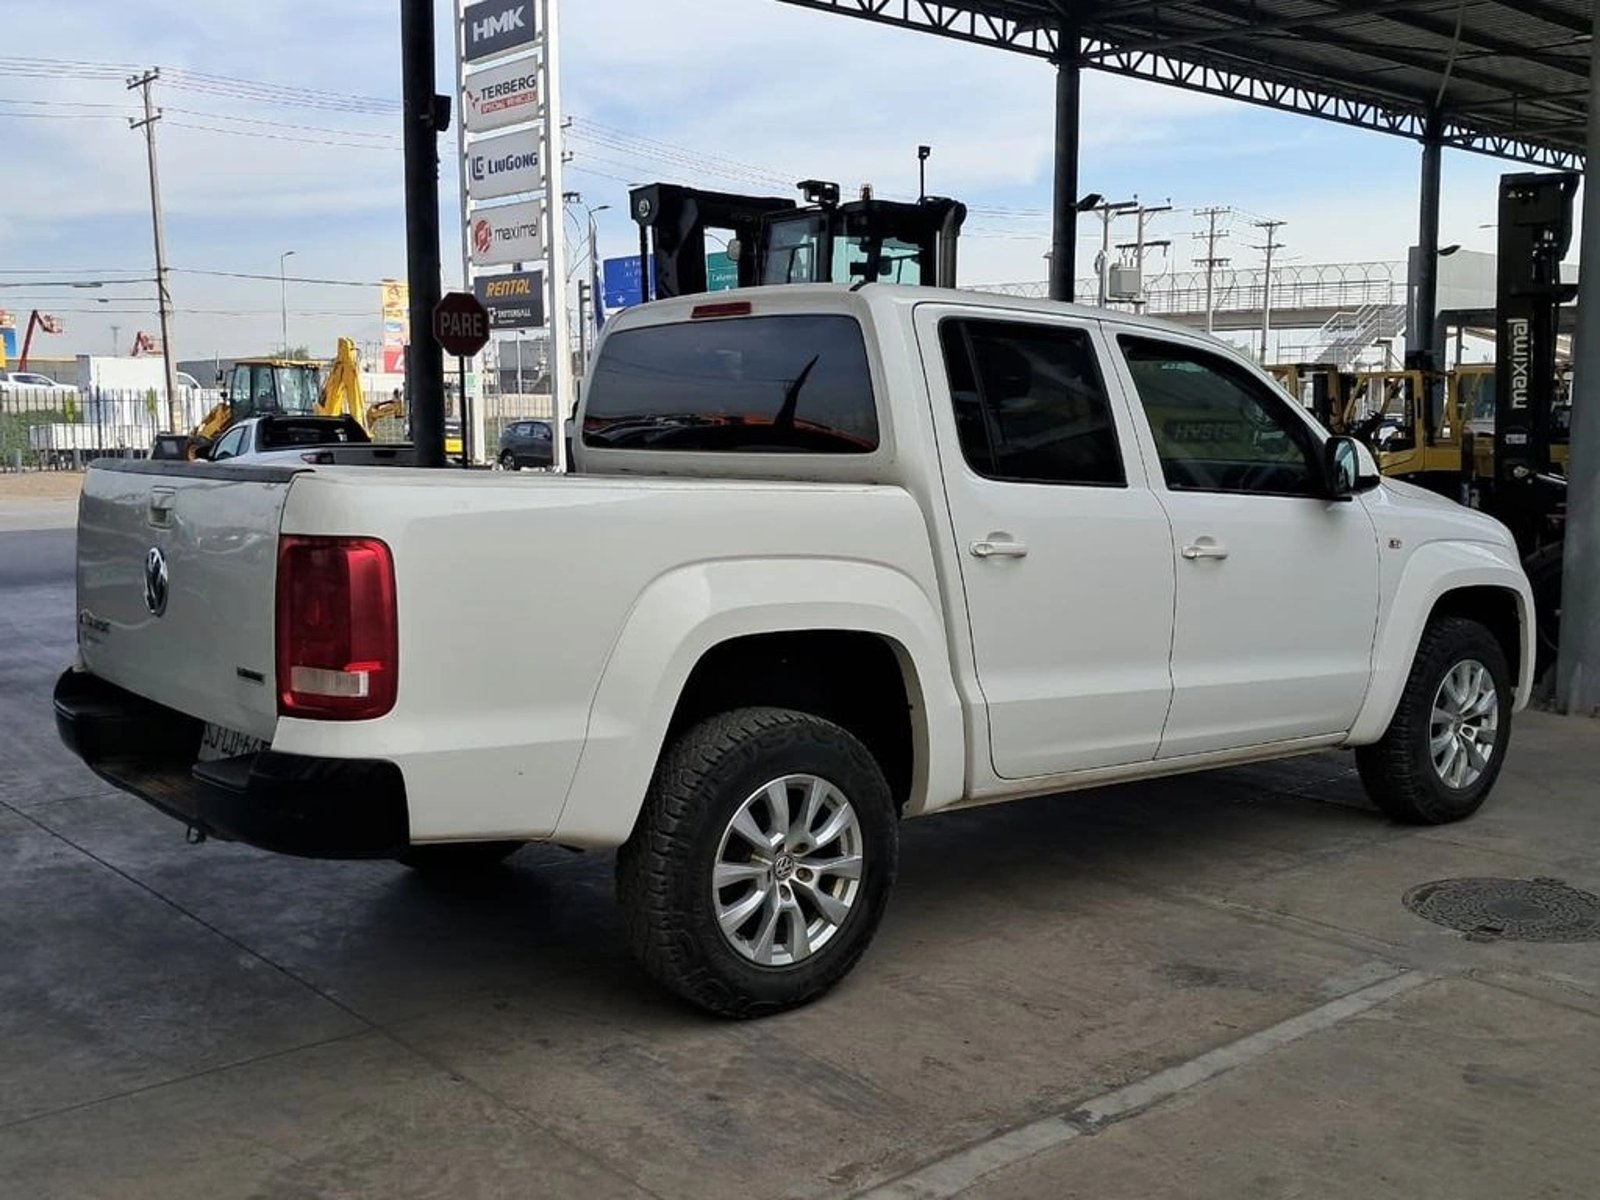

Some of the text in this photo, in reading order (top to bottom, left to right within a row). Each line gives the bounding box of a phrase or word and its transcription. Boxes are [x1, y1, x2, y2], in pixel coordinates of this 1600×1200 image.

[473, 5, 525, 42] HMK
[481, 74, 536, 100] TERBERG
[495, 216, 538, 241] maximal
[486, 278, 531, 298] RENTAL
[440, 312, 483, 337] PARE
[1506, 318, 1528, 409] maximal
